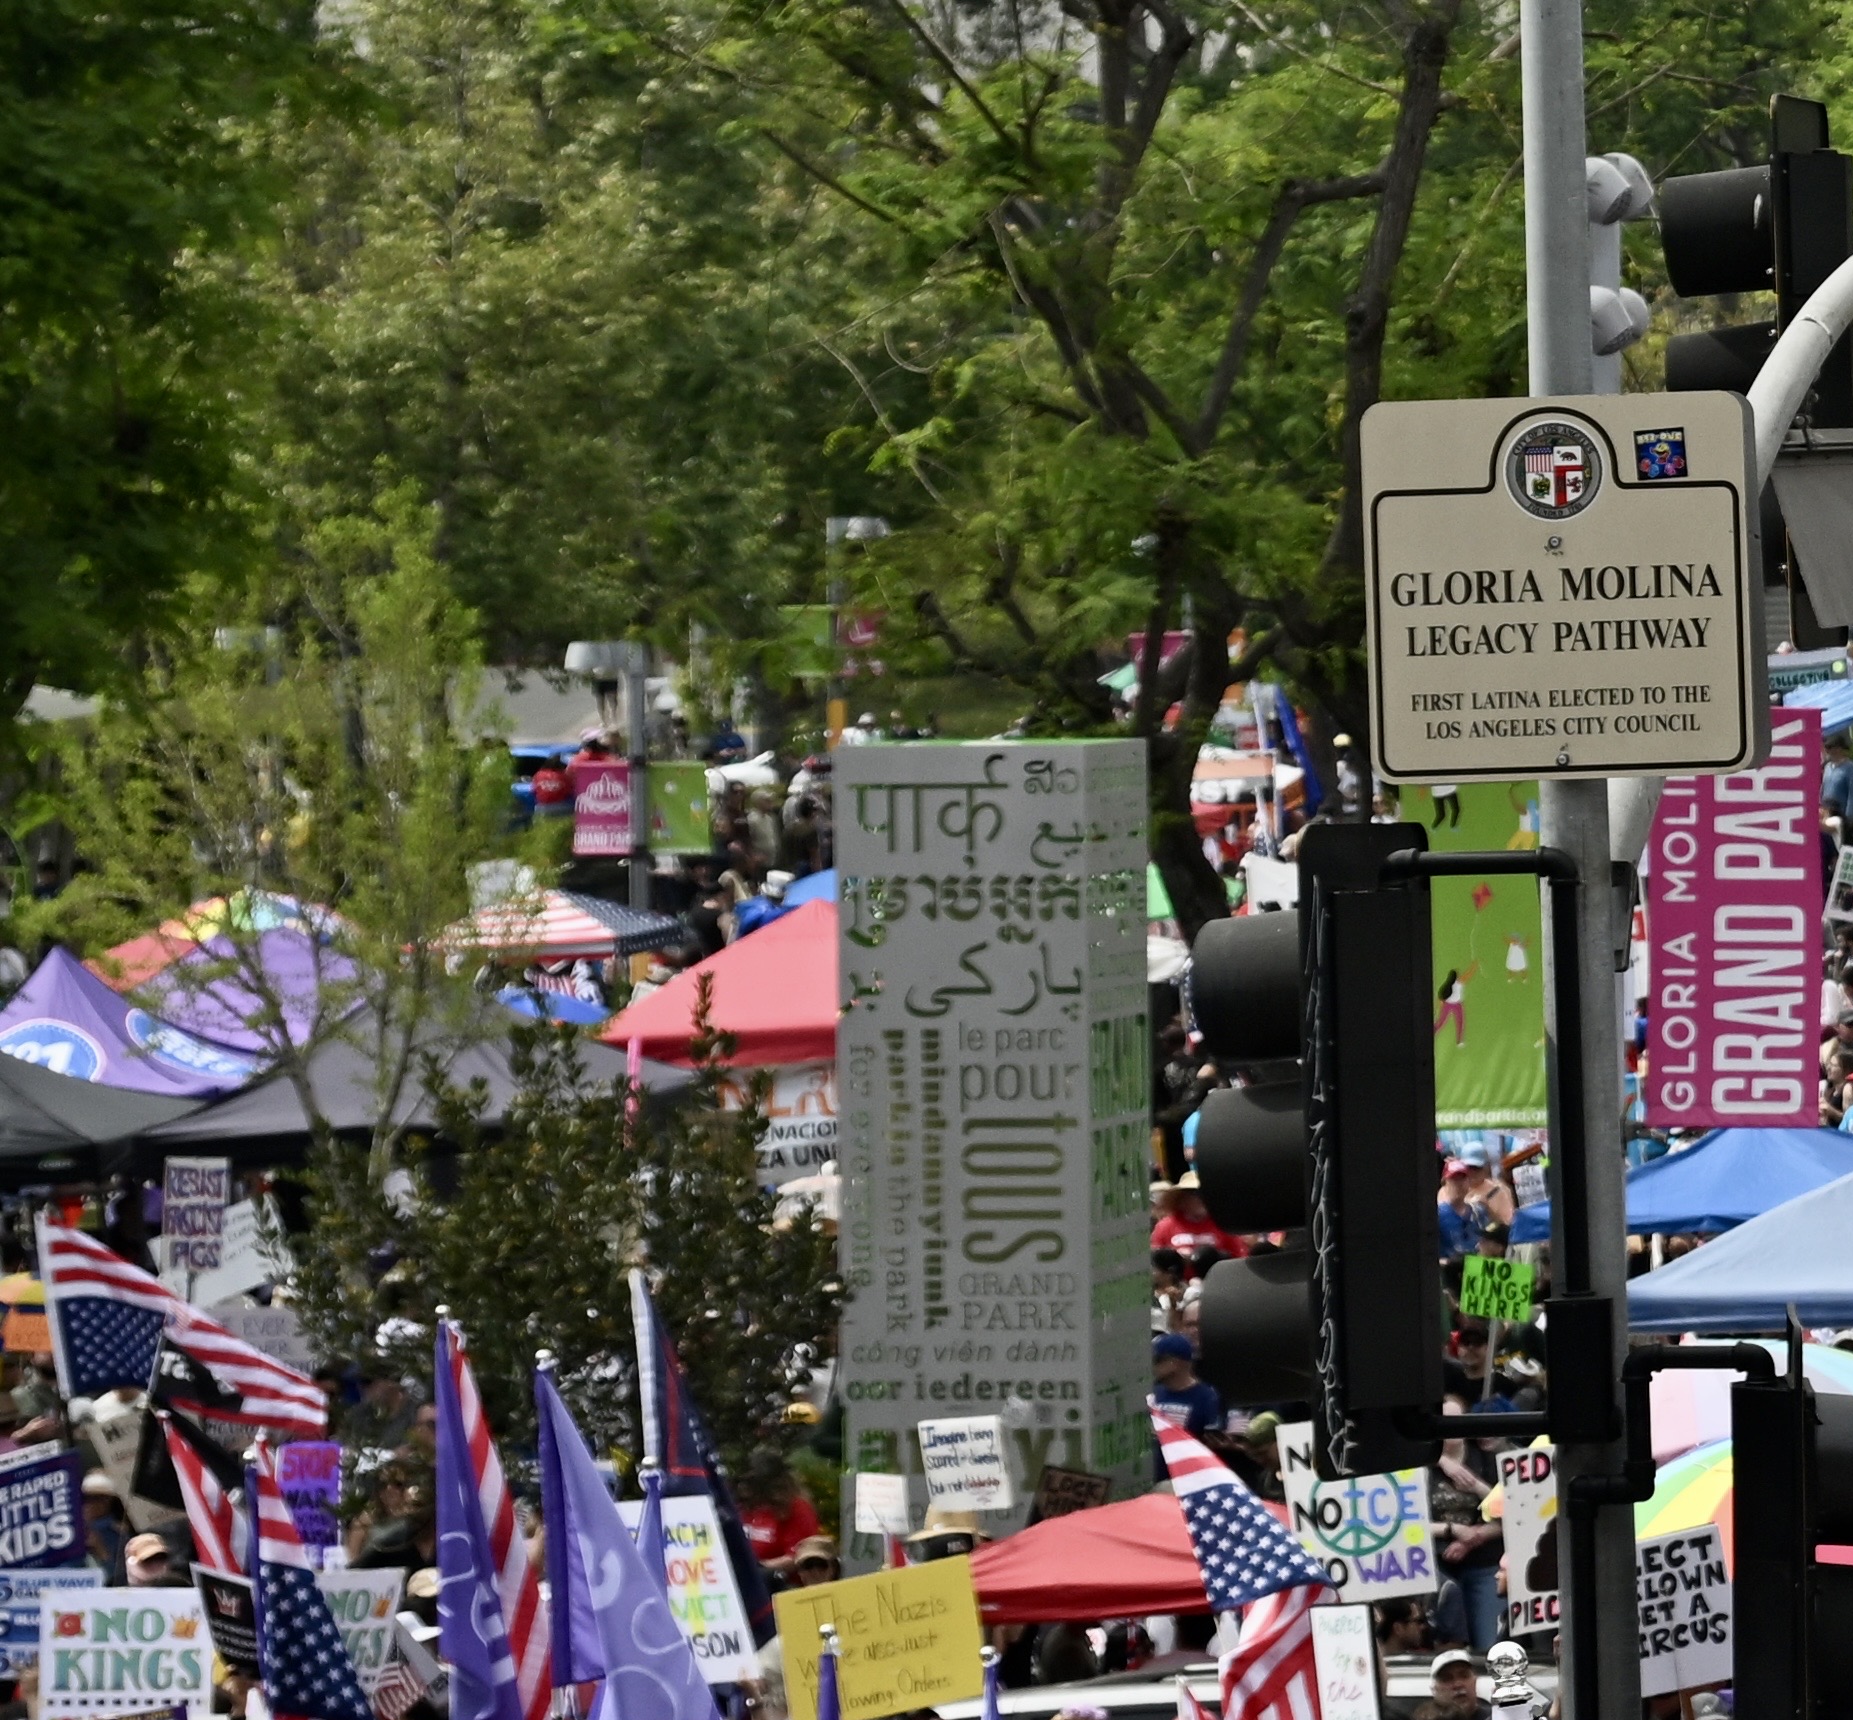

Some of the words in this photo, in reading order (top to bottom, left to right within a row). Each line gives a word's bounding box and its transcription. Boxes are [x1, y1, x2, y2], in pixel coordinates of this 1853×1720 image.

[1389, 569, 1542, 608] GLORIA
[1560, 562, 1722, 601] MOLINA
[1405, 622, 1539, 657] LEGACY
[1553, 618, 1712, 652] PATHWAY
[1411, 690, 1464, 712] FIRST
[1470, 689, 1542, 711] LATINA
[1548, 686, 1636, 709] ELECTED
[1641, 686, 1664, 706] TO
[1672, 684, 1711, 705] THE
[1425, 719, 1462, 740] LOS
[1469, 717, 1558, 738] ANGELES
[1563, 716, 1608, 736] CITY
[1613, 713, 1701, 734] COUNCIL
[1711, 905, 1803, 1116] GRAND
[1661, 941, 1698, 1112] GLORIA
[958, 1273, 1076, 1297] GRAND
[1481, 1261, 1512, 1281] NO
[1465, 1276, 1533, 1302] KINGS
[960, 1302, 1076, 1330] PARK
[1466, 1297, 1522, 1319] HERE
[90, 1608, 165, 1642] NO
[52, 1648, 202, 1693] KINGS
